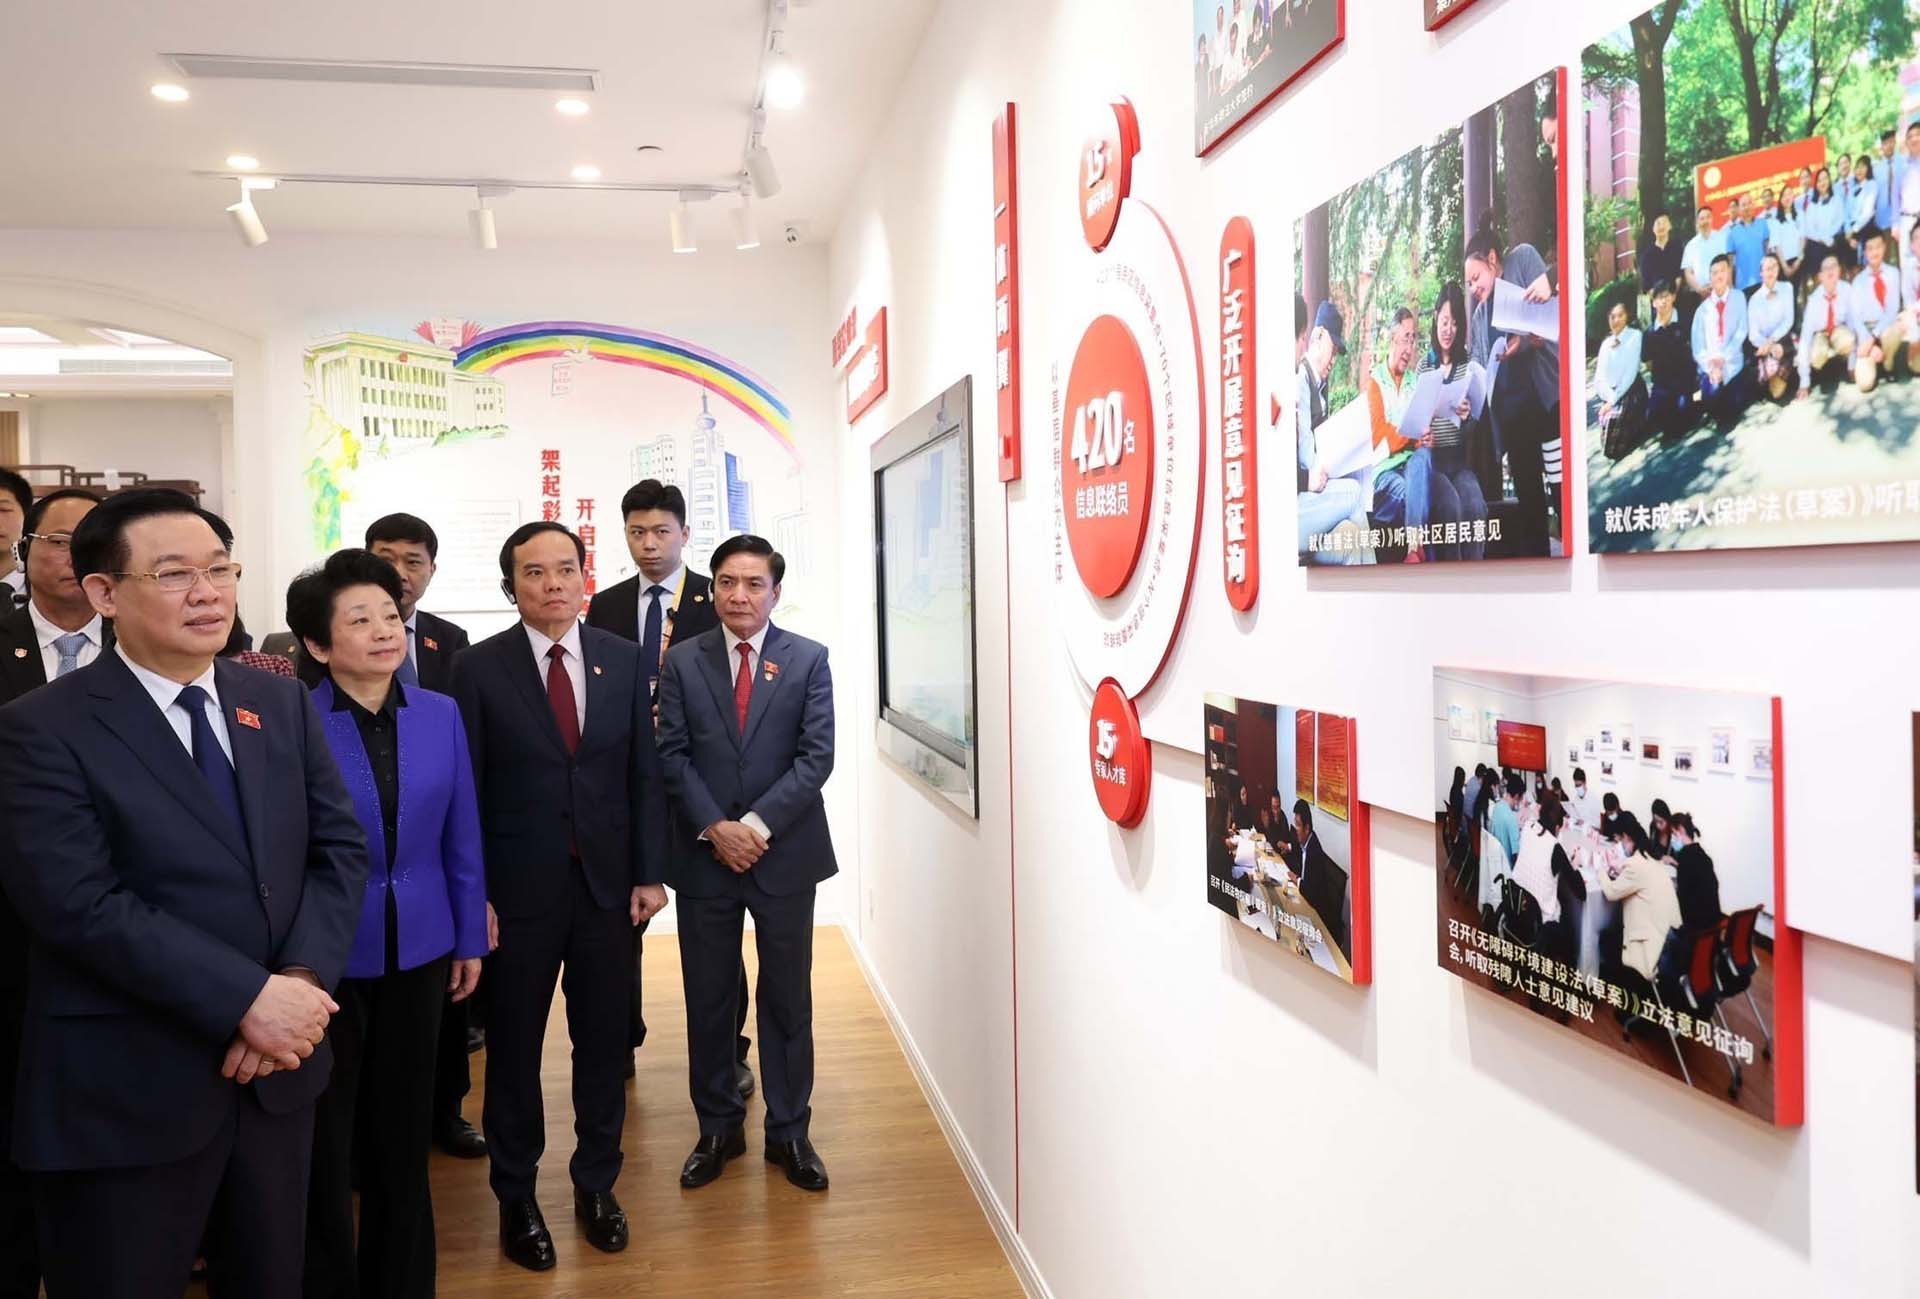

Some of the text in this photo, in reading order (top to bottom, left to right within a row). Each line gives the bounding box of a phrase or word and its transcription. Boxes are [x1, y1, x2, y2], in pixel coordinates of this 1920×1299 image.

[1075, 481, 1129, 519] 信息联络员
